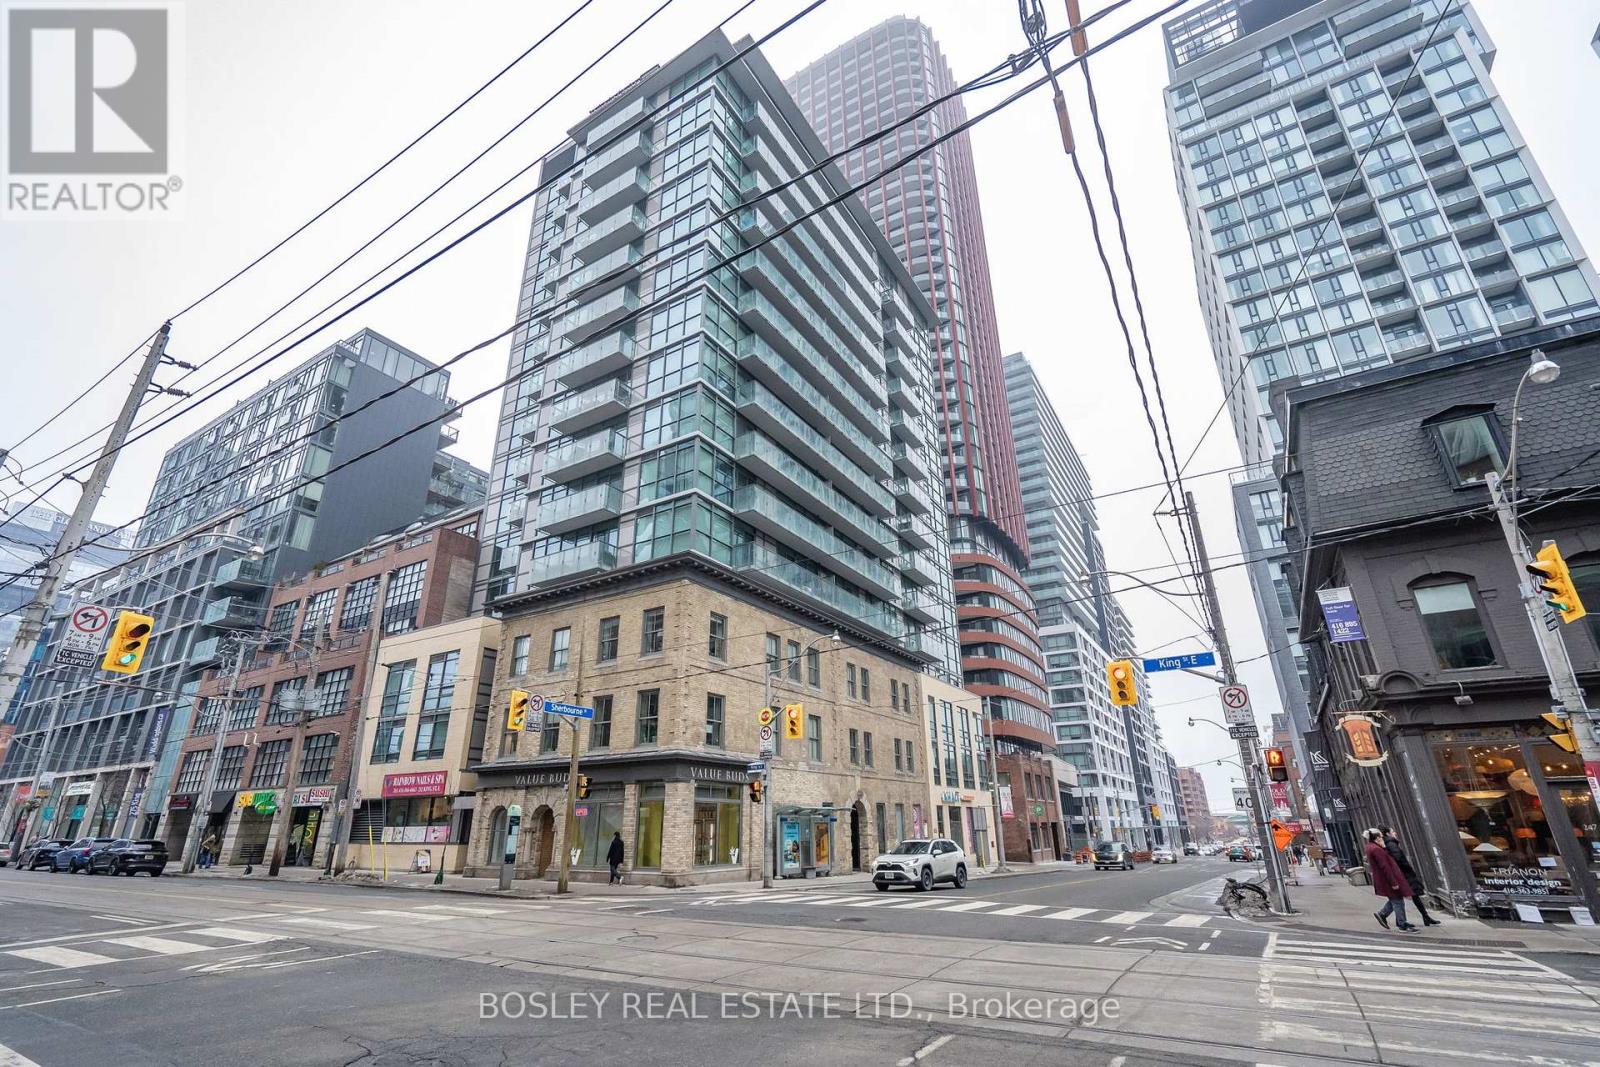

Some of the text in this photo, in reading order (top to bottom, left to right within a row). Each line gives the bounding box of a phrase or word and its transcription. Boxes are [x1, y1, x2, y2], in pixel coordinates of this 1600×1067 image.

[57, 655, 93, 667] EXCEPTED
[1158, 659, 1181, 669] King
[1190, 655, 1198, 665] E
[551, 703, 584, 716] Sherbourne
[515, 772, 571, 785] VALUE BUD
[690, 766, 750, 782] VALUE BUDS
[310, 788, 332, 798] SUSHI
[1490, 866, 1548, 876] TRIANON
[1528, 877, 1562, 888] design
